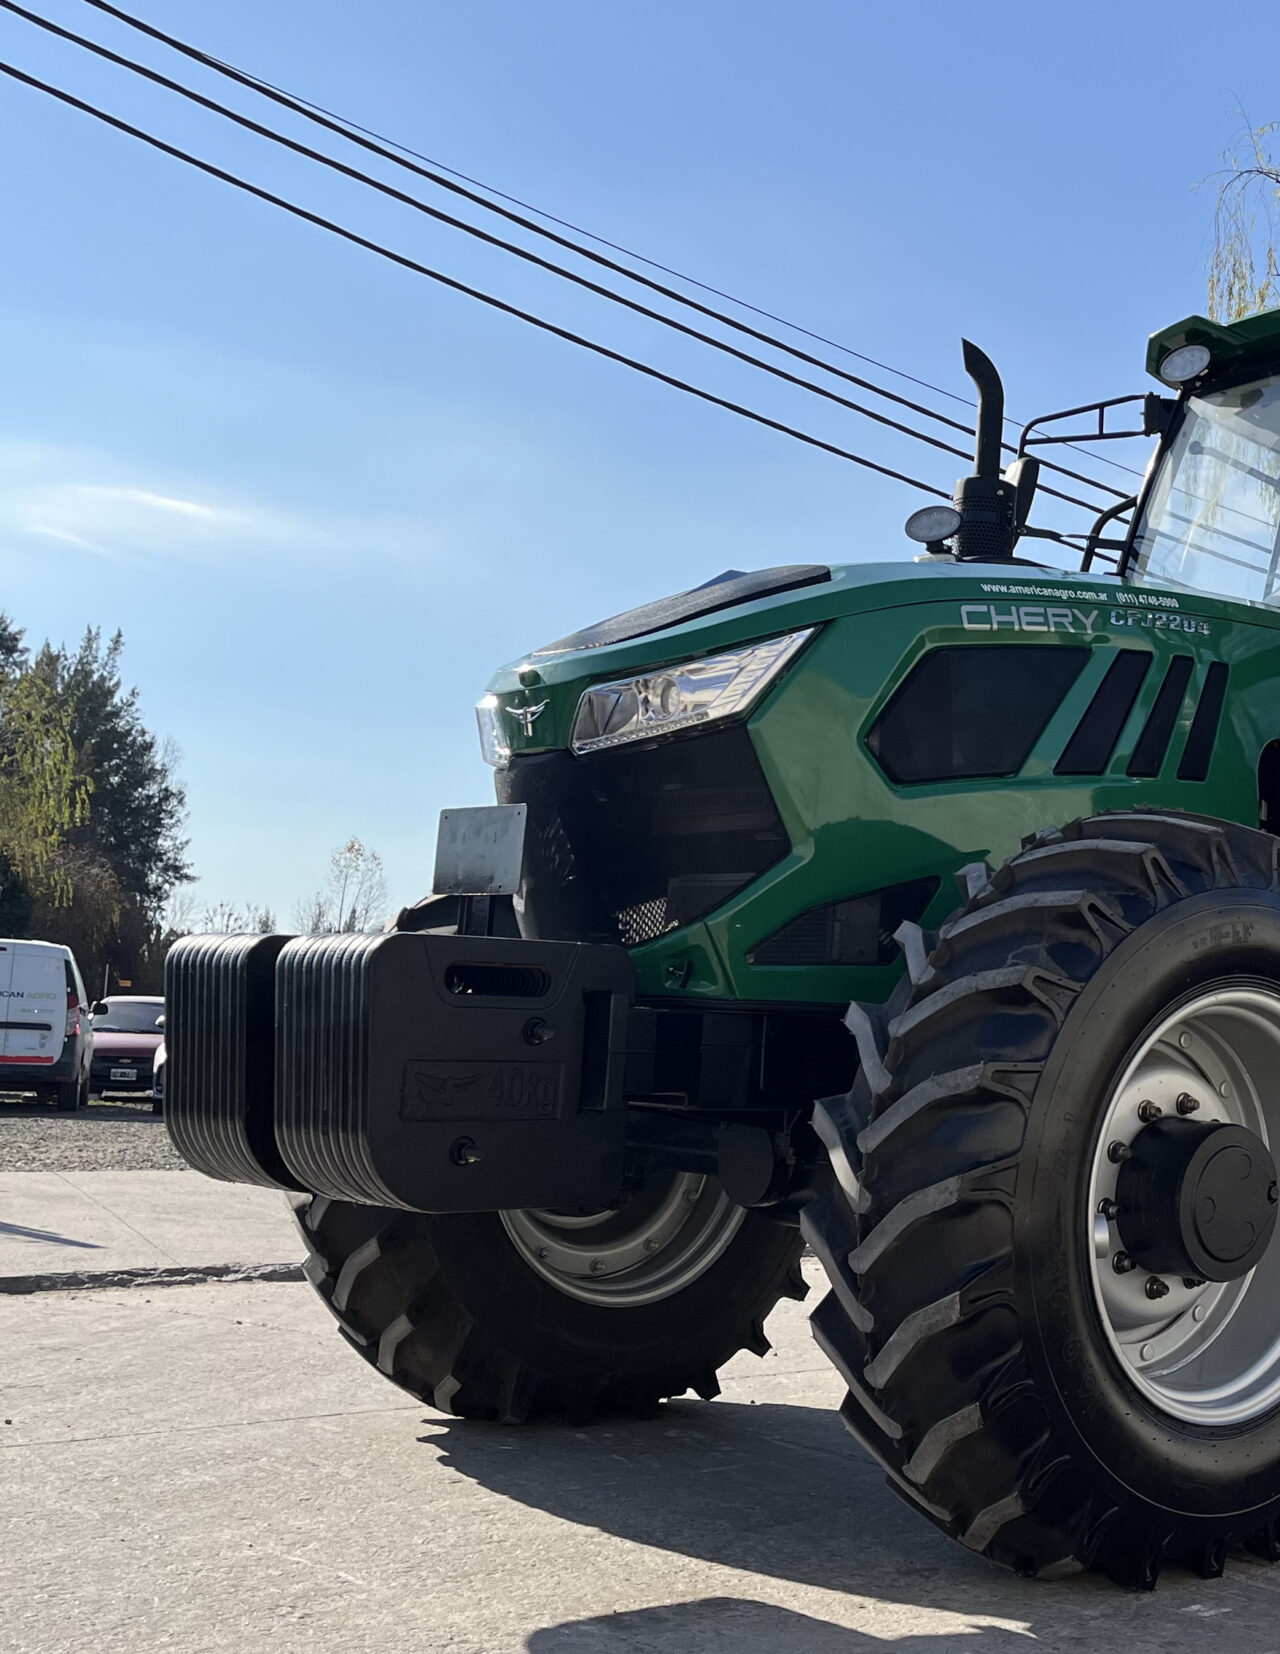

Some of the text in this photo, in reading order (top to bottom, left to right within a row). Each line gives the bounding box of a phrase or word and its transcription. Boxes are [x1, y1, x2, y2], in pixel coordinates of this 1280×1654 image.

[980, 584, 1108, 600] www.americanagro.com.ar
[1115, 591, 1139, 606] (011)
[960, 604, 1211, 635] CHERY CFJ2204
